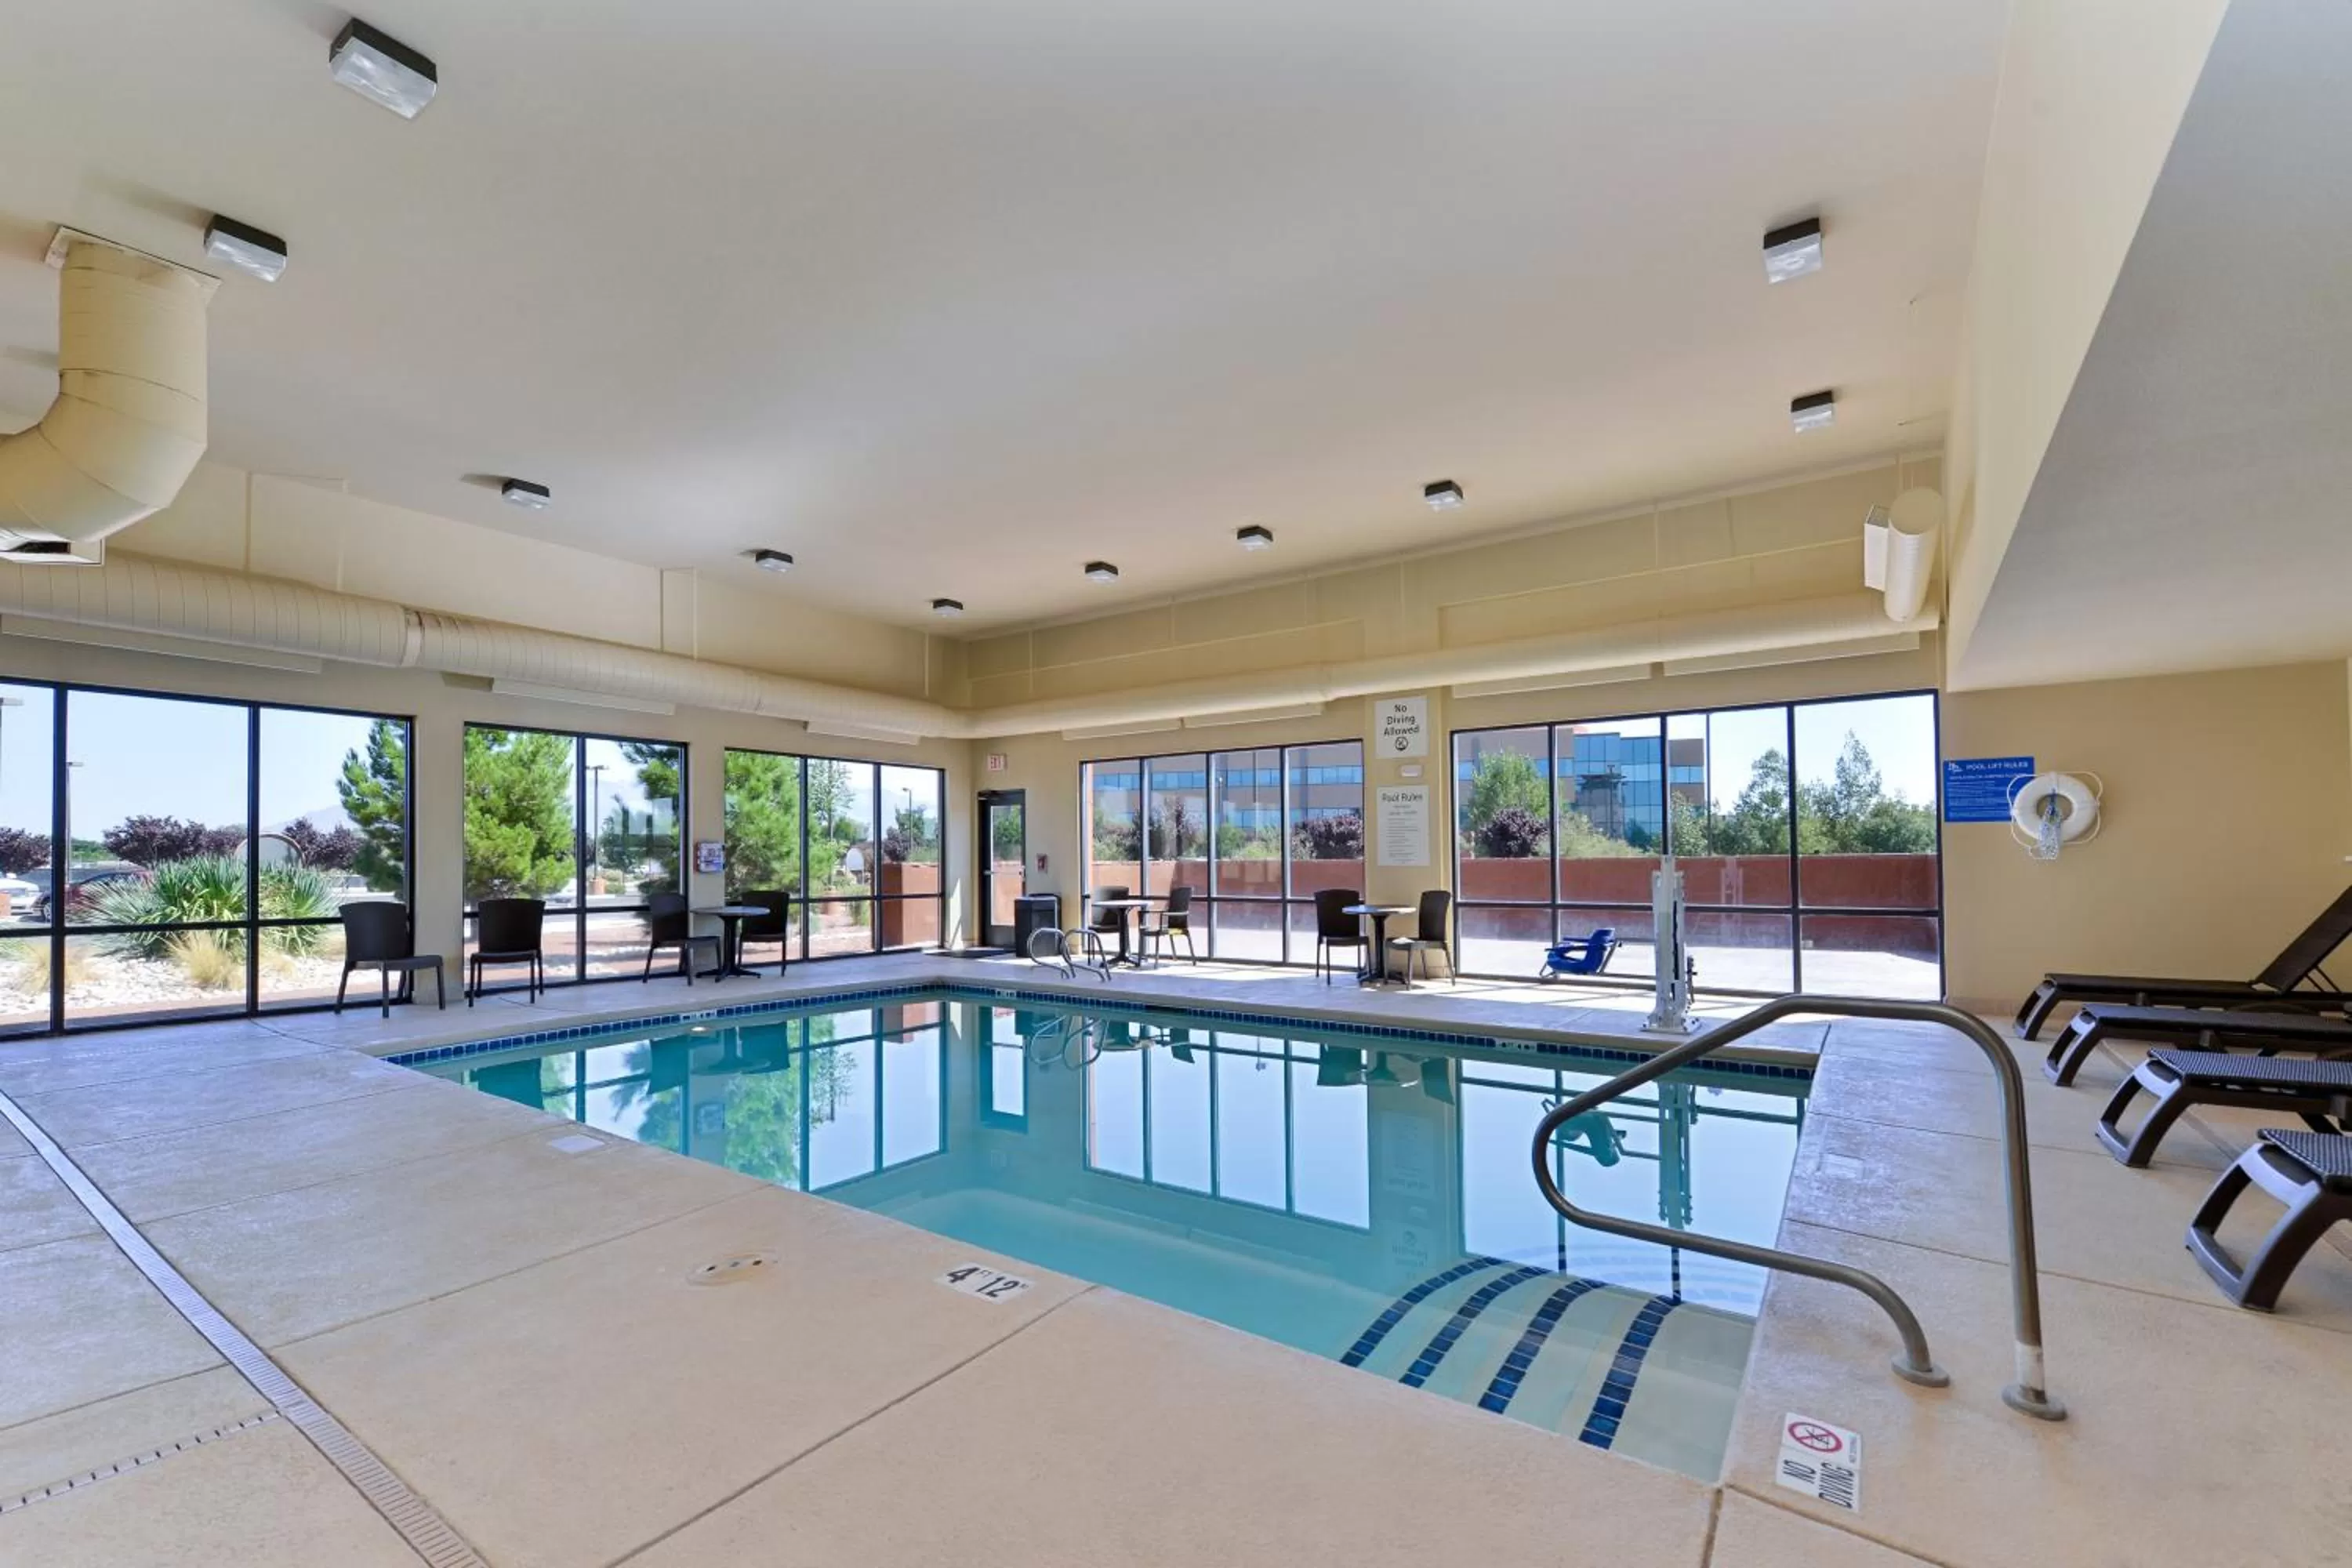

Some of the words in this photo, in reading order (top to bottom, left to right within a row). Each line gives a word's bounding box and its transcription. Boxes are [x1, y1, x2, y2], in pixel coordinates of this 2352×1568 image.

[1395, 704, 1407, 713] No
[1387, 714, 1416, 725] Diving
[1384, 725, 1420, 735] Allowed
[1783, 1459, 1816, 1484] NO
[1818, 1461, 1855, 1509] DIVING
